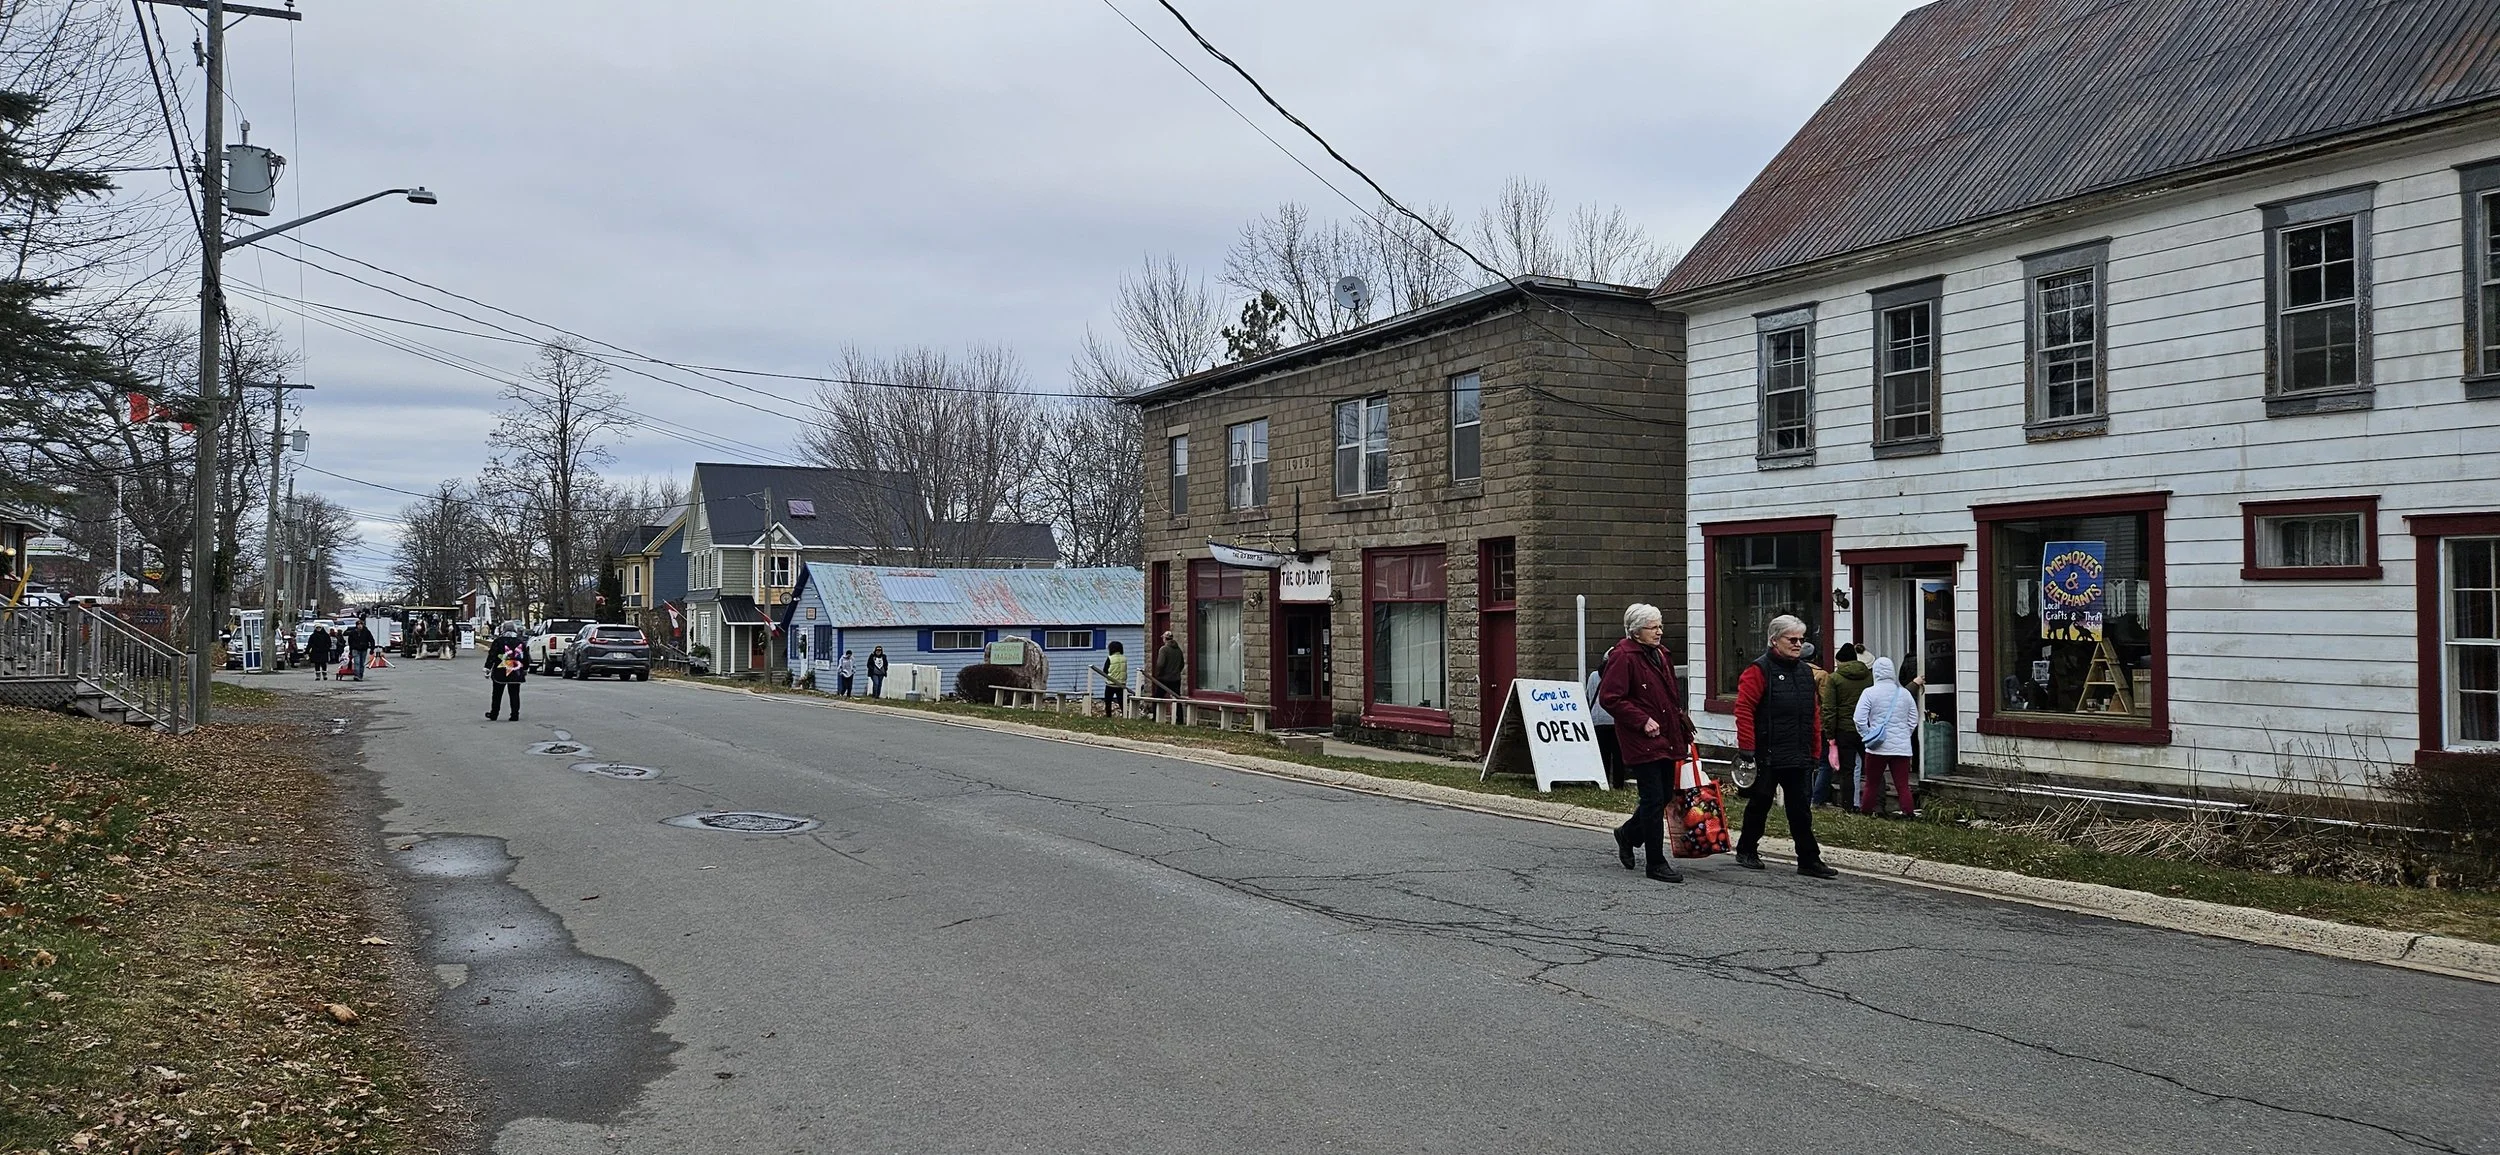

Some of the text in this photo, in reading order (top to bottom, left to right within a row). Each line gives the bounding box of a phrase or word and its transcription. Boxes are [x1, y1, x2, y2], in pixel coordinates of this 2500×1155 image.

[2045, 550, 2103, 579] MEMORIES
[1281, 570, 1294, 586] THE
[1308, 568, 1325, 586] BOOT
[2065, 571, 2079, 590] &
[2044, 580, 2102, 607] ELEPHANTS
[2043, 599, 2060, 610] Local
[2045, 611, 2103, 622] Crafts & Thrift
[1531, 687, 1570, 702] Come in
[1550, 702, 1577, 712] we're
[1536, 720, 1590, 743] OPEN
